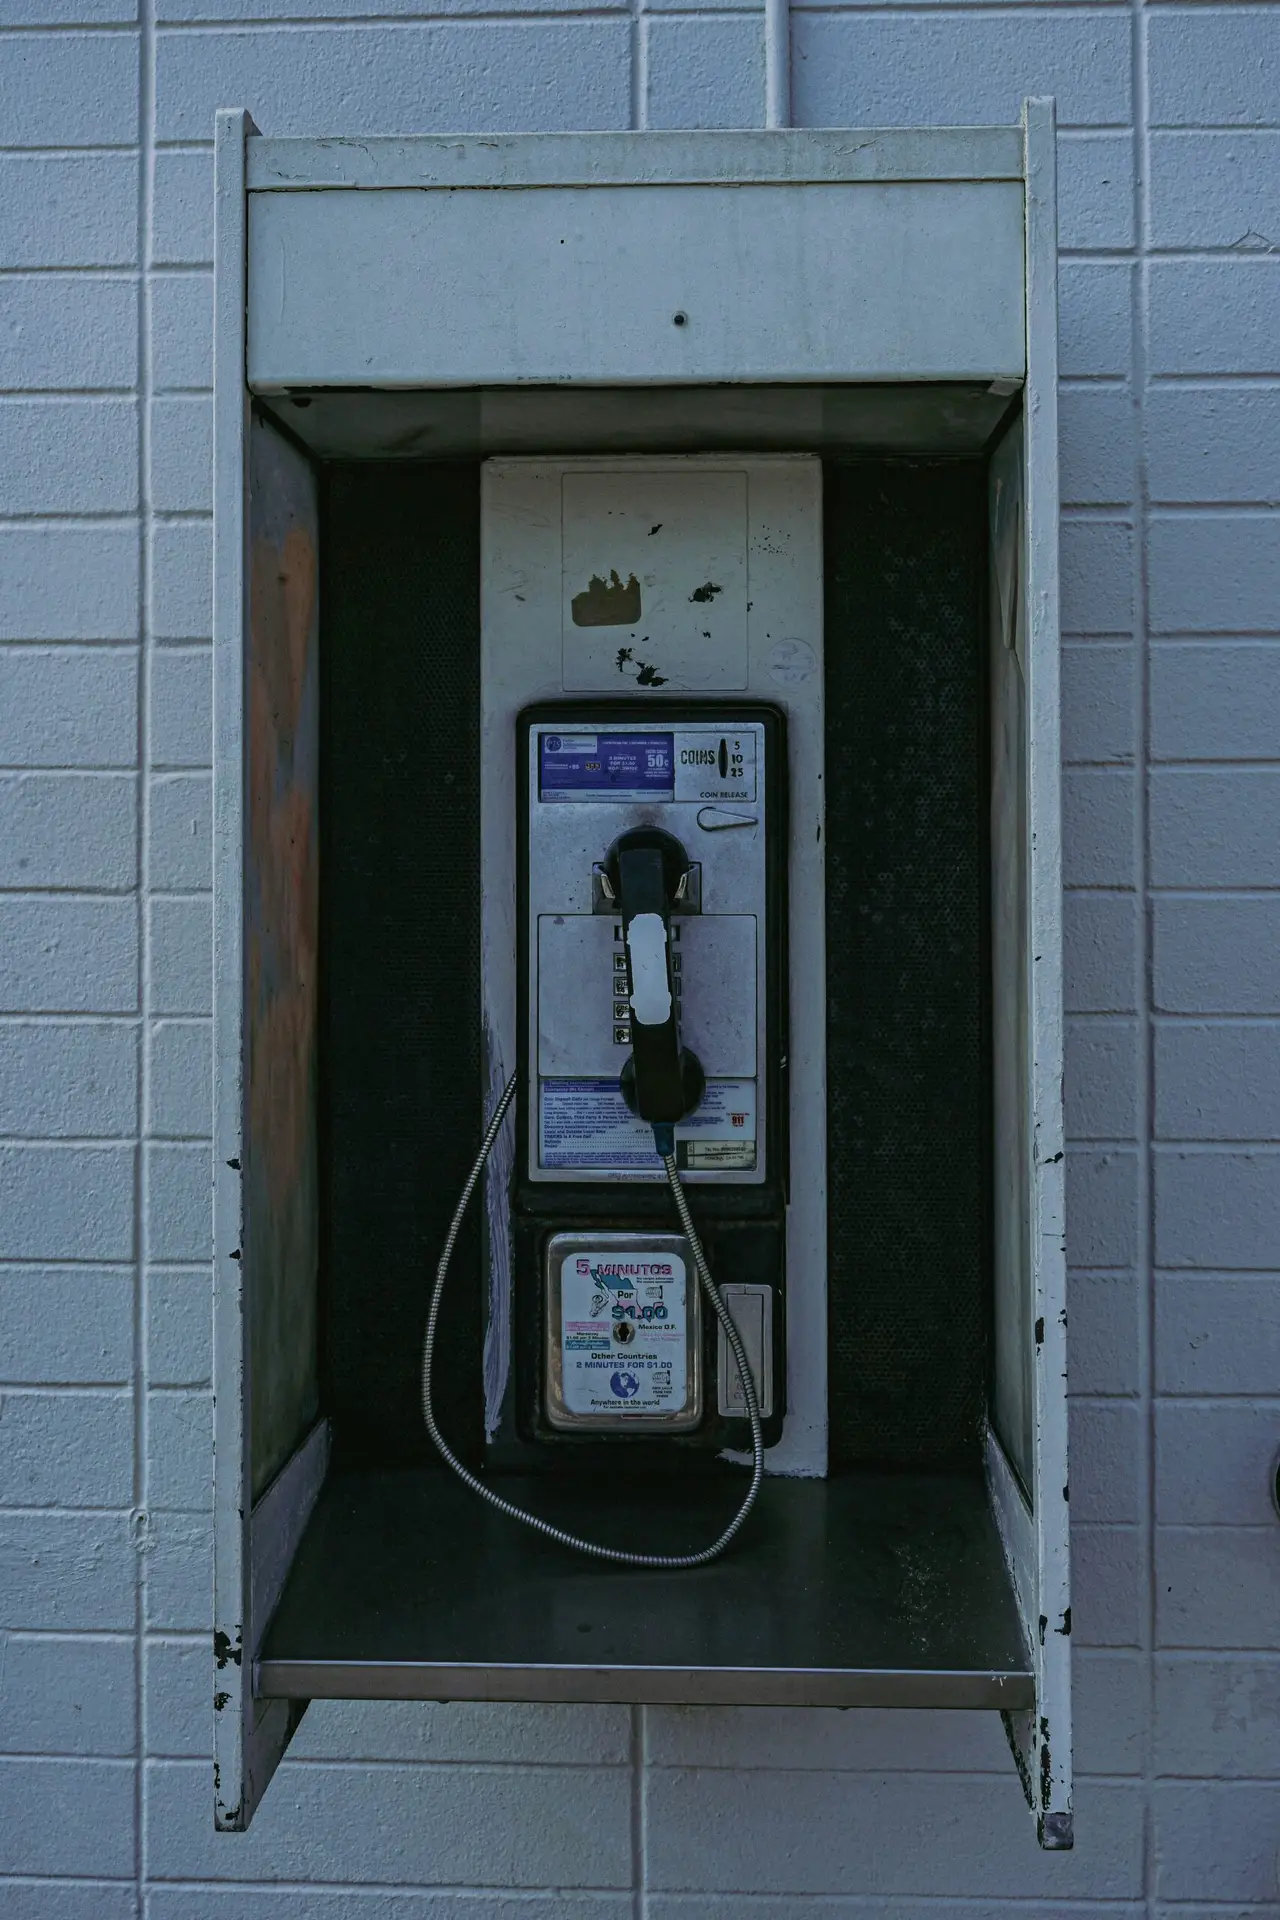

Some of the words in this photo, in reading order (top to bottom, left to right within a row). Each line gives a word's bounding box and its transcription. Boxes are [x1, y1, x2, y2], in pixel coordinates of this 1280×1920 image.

[734, 741, 740, 750] 5
[681, 750, 716, 765] COINS
[732, 754, 744, 764] 10
[731, 768, 744, 777] 25
[732, 1116, 744, 1124] 911
[576, 1259, 590, 1276] 5
[597, 1264, 672, 1276] MINUTOS
[618, 1290, 634, 1299] Por
[612, 1306, 668, 1320] $1.00
